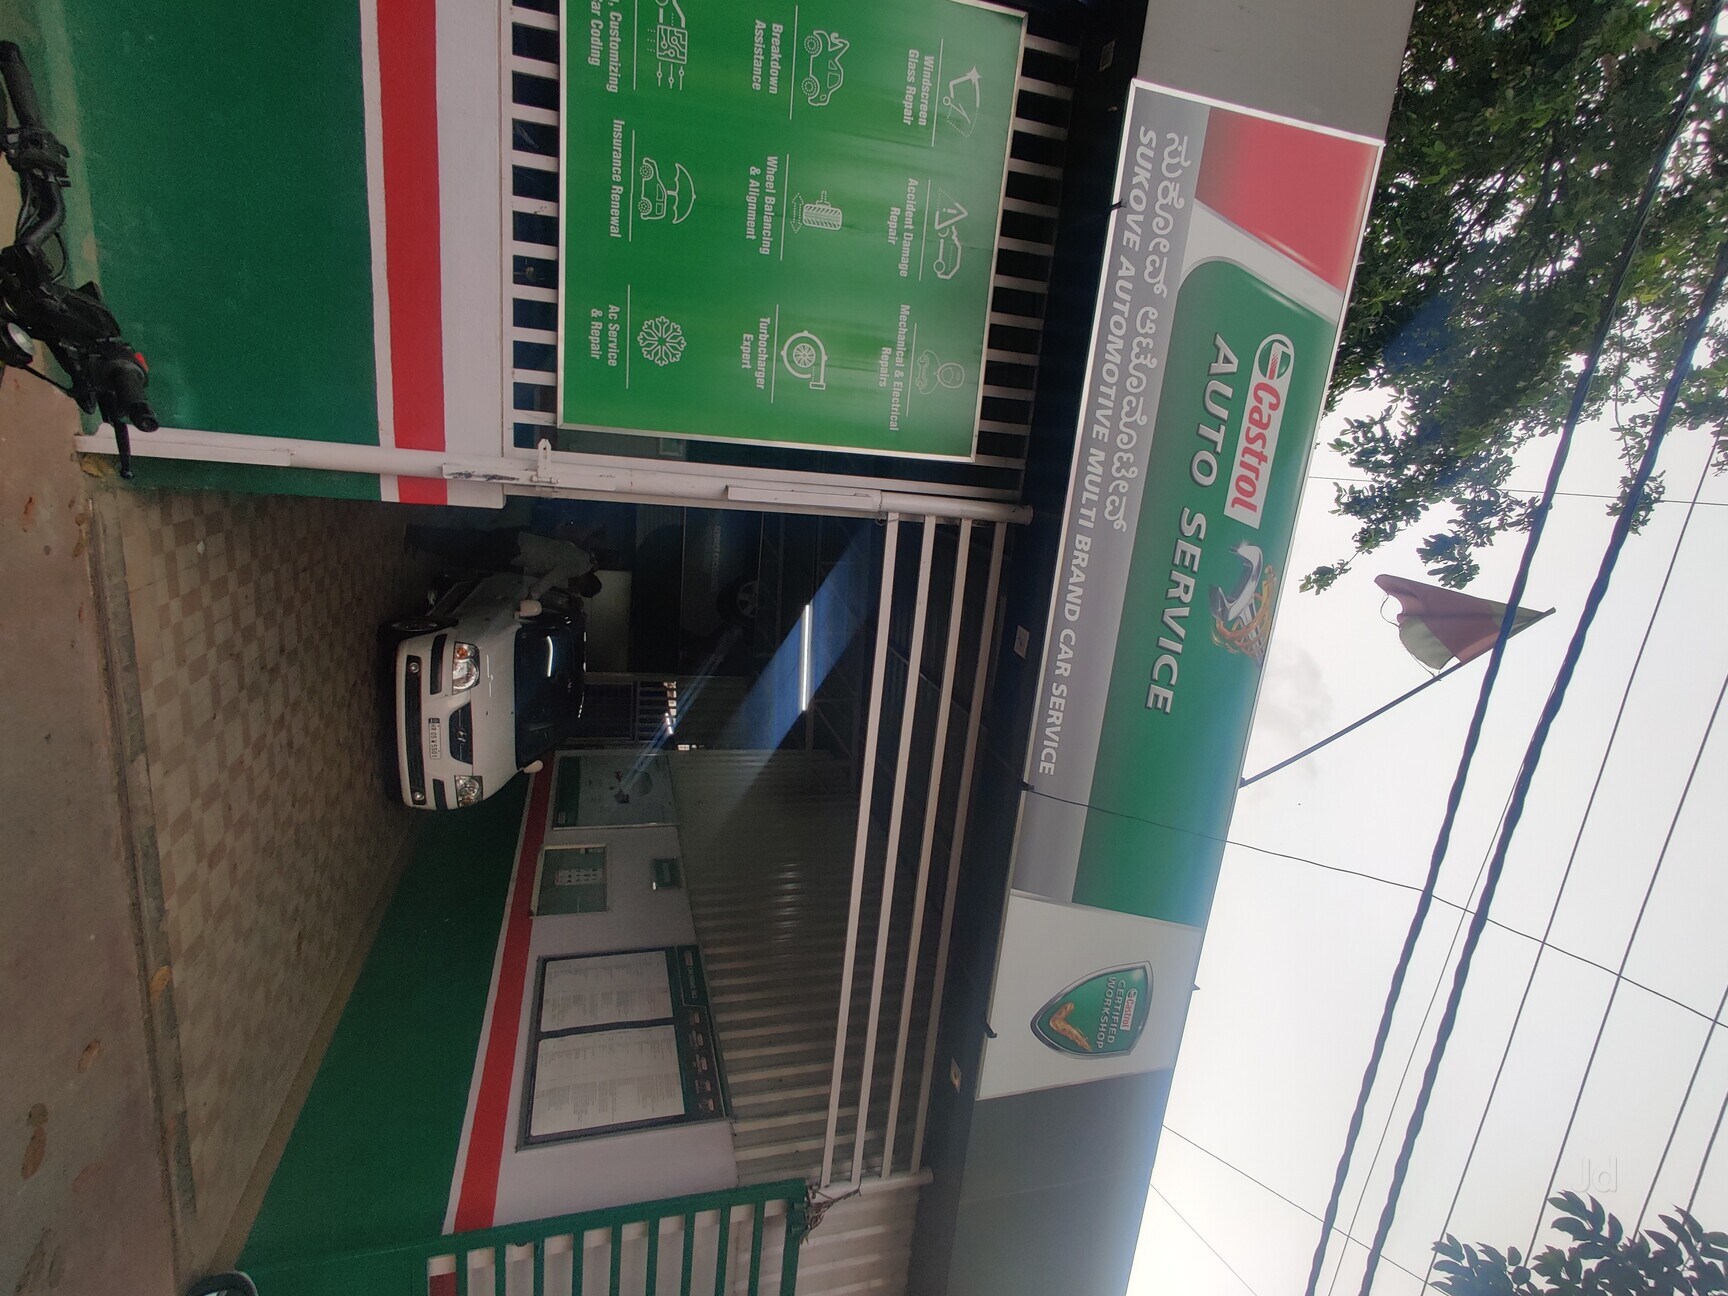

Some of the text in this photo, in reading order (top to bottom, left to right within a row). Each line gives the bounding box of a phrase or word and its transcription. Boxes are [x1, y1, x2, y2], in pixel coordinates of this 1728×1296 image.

[588, 19, 603, 66] Coding
[606, 12, 622, 93] Customizing
[752, 19, 766, 91] Assistance
[768, 23, 783, 94] Breakdown
[902, 49, 919, 125] Glass Repair
[918, 55, 934, 126] Windscreen
[610, 119, 625, 238] Insurance Renewal
[744, 166, 761, 240] & Alignment
[759, 156, 778, 255] Wheel Balancing
[886, 207, 901, 244] Repair
[898, 178, 919, 277] Accident Damage
[588, 309, 603, 359] & Repair
[606, 305, 621, 366] Ac Service
[739, 333, 754, 369] Expert
[754, 317, 771, 389] Turbocharger
[878, 347, 892, 387] Repairs
[889, 304, 911, 431] Mechanical & Electrical
[1038, 126, 1157, 775] SUKOVE AUTOMOTIVE MULTI BRAND CAR SERVICE
[1229, 381, 1281, 511] Castrol
[1144, 333, 1239, 715] AUTO SERVICE
[1096, 976, 1116, 1049] WORKSHOP
[1107, 979, 1125, 1043] CERTIFIED
[1121, 998, 1135, 1028] Castrol
